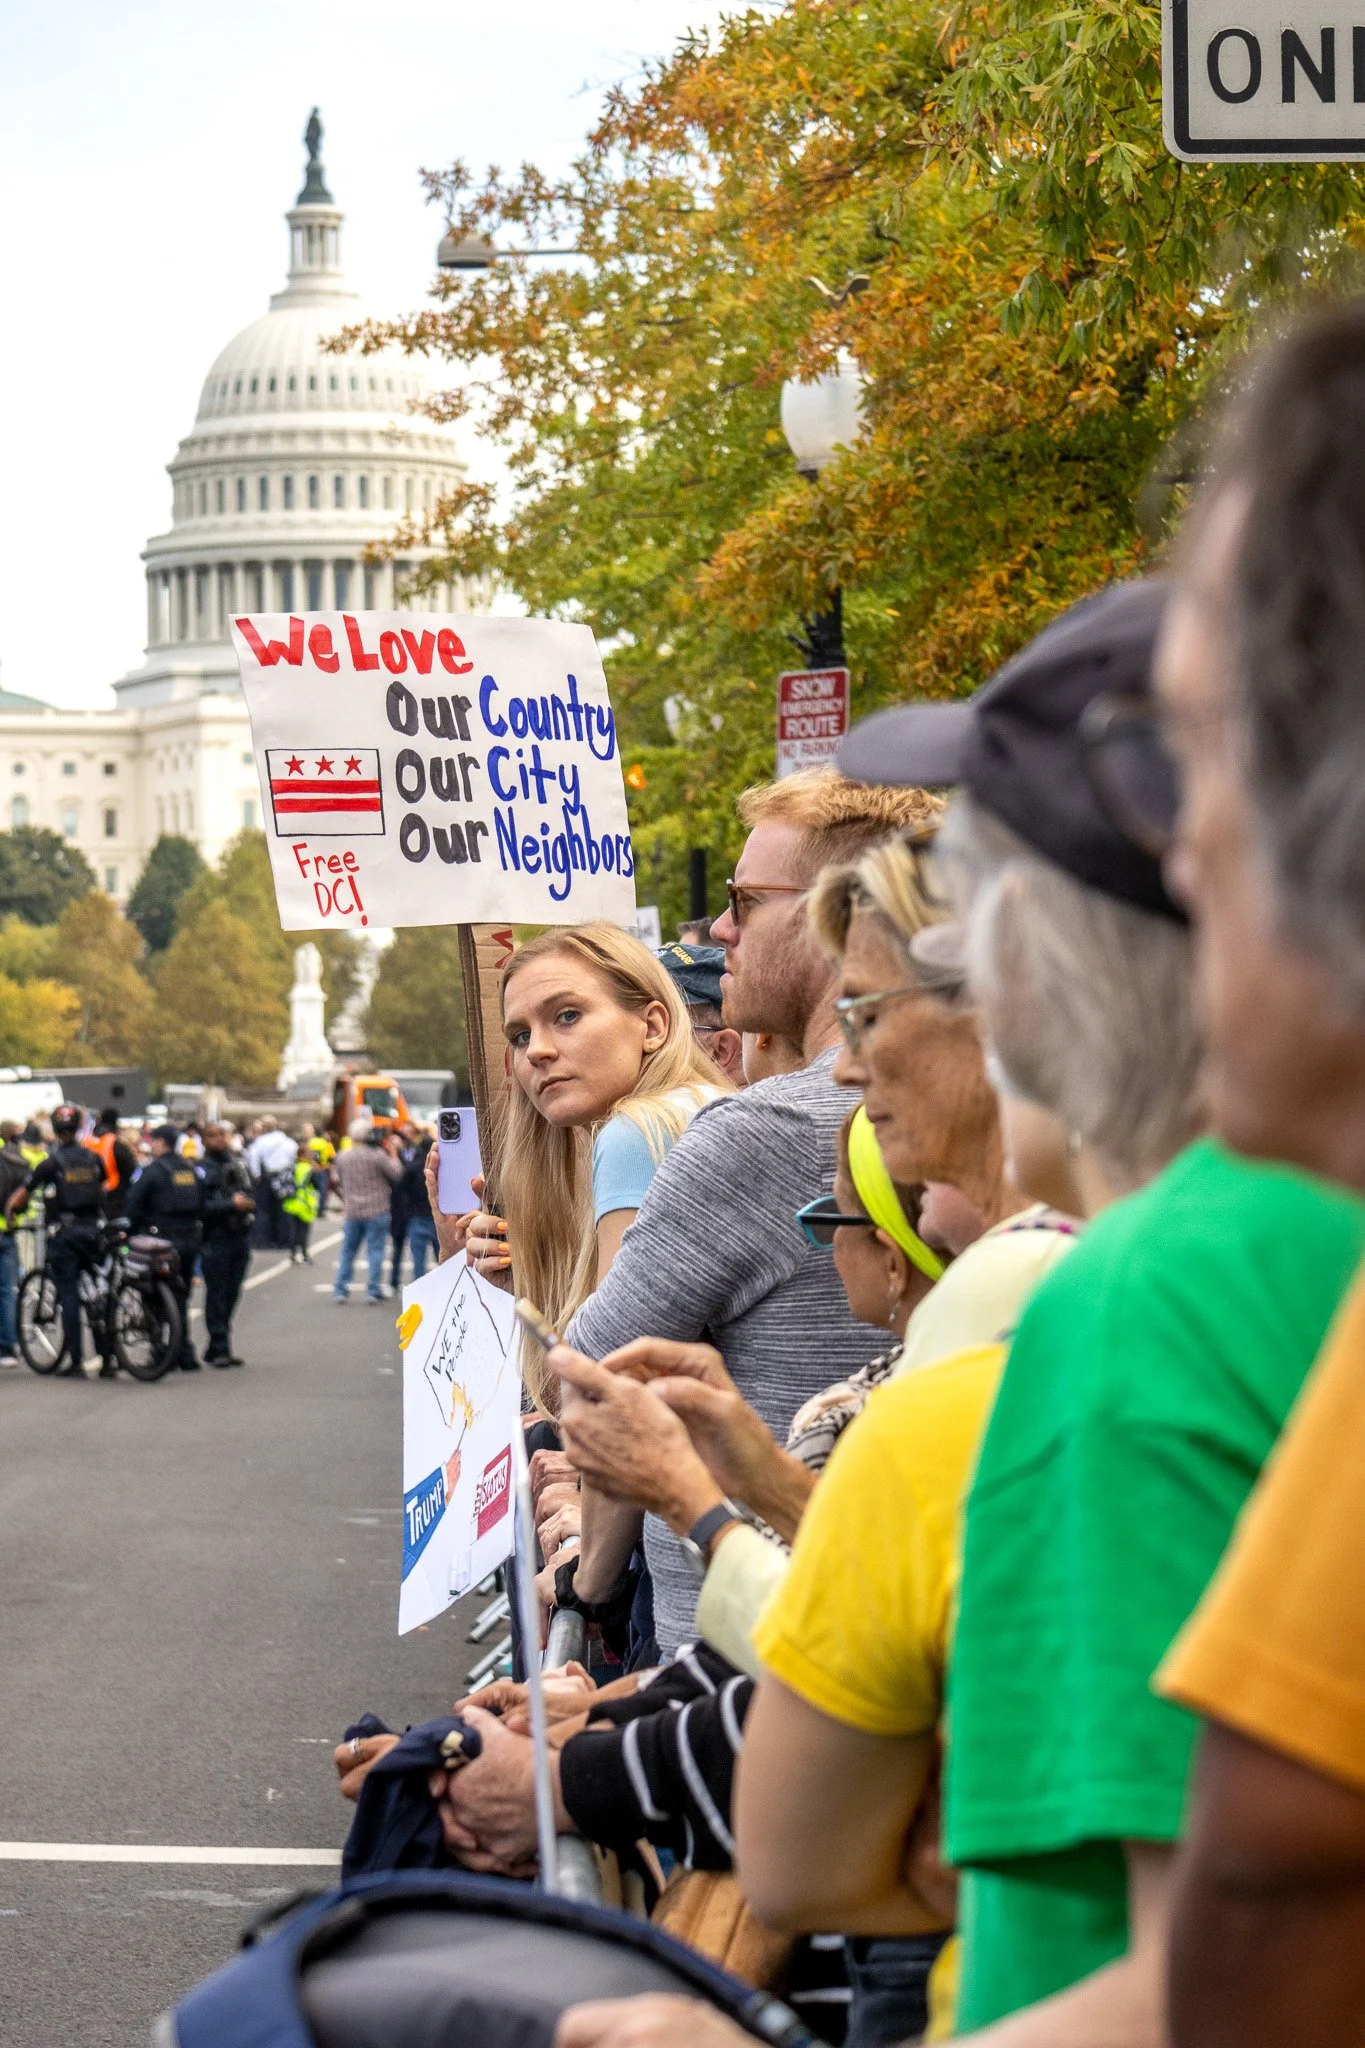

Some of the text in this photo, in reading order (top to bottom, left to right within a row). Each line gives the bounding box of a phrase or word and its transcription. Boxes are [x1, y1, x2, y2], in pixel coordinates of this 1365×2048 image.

[235, 614, 473, 675] We Love
[781, 697, 843, 717] EMERGENCY
[790, 677, 836, 700] SNOW
[386, 674, 615, 761] Our Country
[785, 714, 841, 739] ROUTE
[395, 744, 580, 816] Our City
[292, 842, 360, 878] Free
[399, 799, 633, 901] Our Neighbors
[314, 875, 369, 927] DC!
[480, 1464, 507, 1507] SCOTUS
